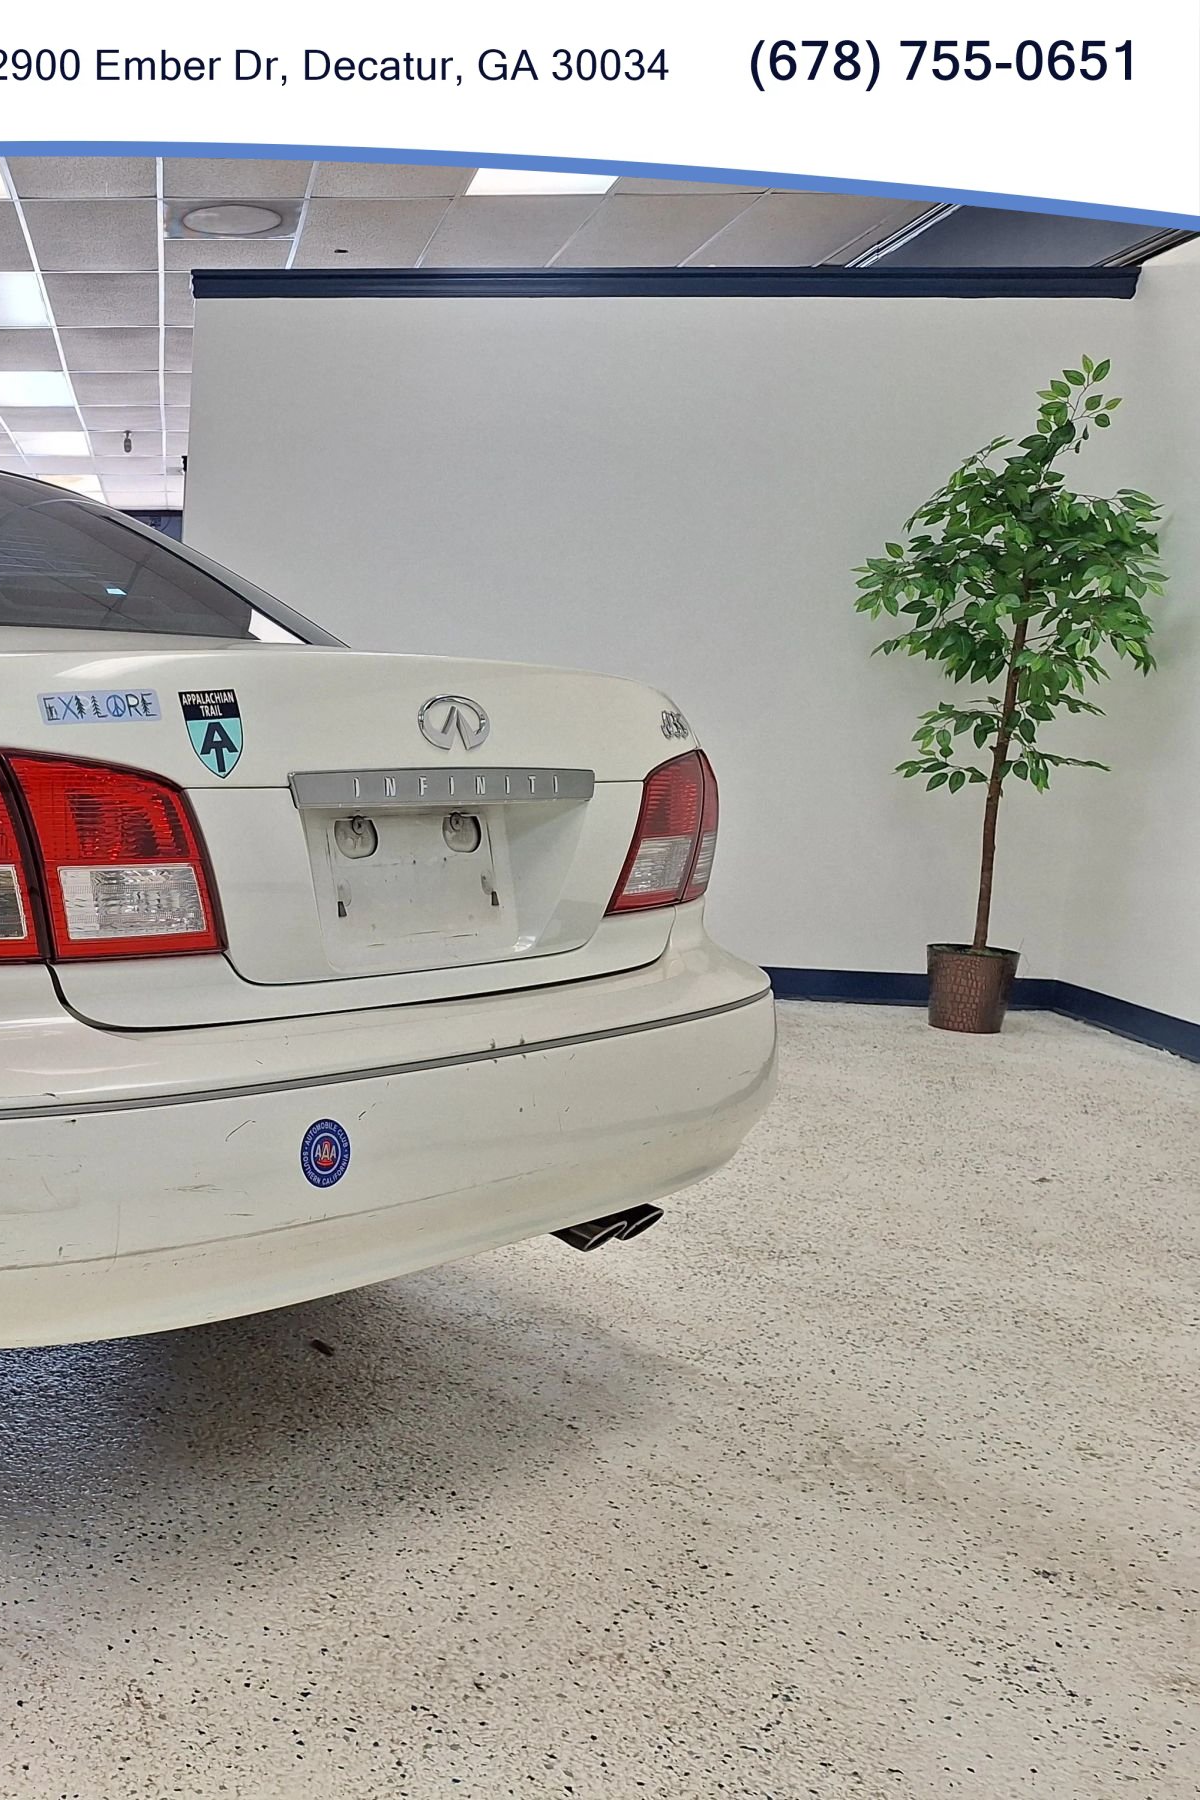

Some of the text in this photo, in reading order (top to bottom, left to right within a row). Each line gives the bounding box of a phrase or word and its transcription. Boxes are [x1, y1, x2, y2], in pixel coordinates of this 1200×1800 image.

[181, 690, 235, 706] APPALACHIAN
[199, 704, 223, 717] TRAIL
[353, 775, 559, 798] INFINITI
[337, 1129, 349, 1148] CLUB
[314, 1143, 337, 1161] AAA
[302, 1151, 350, 1186] SOUTHERN CALIFORNIA
